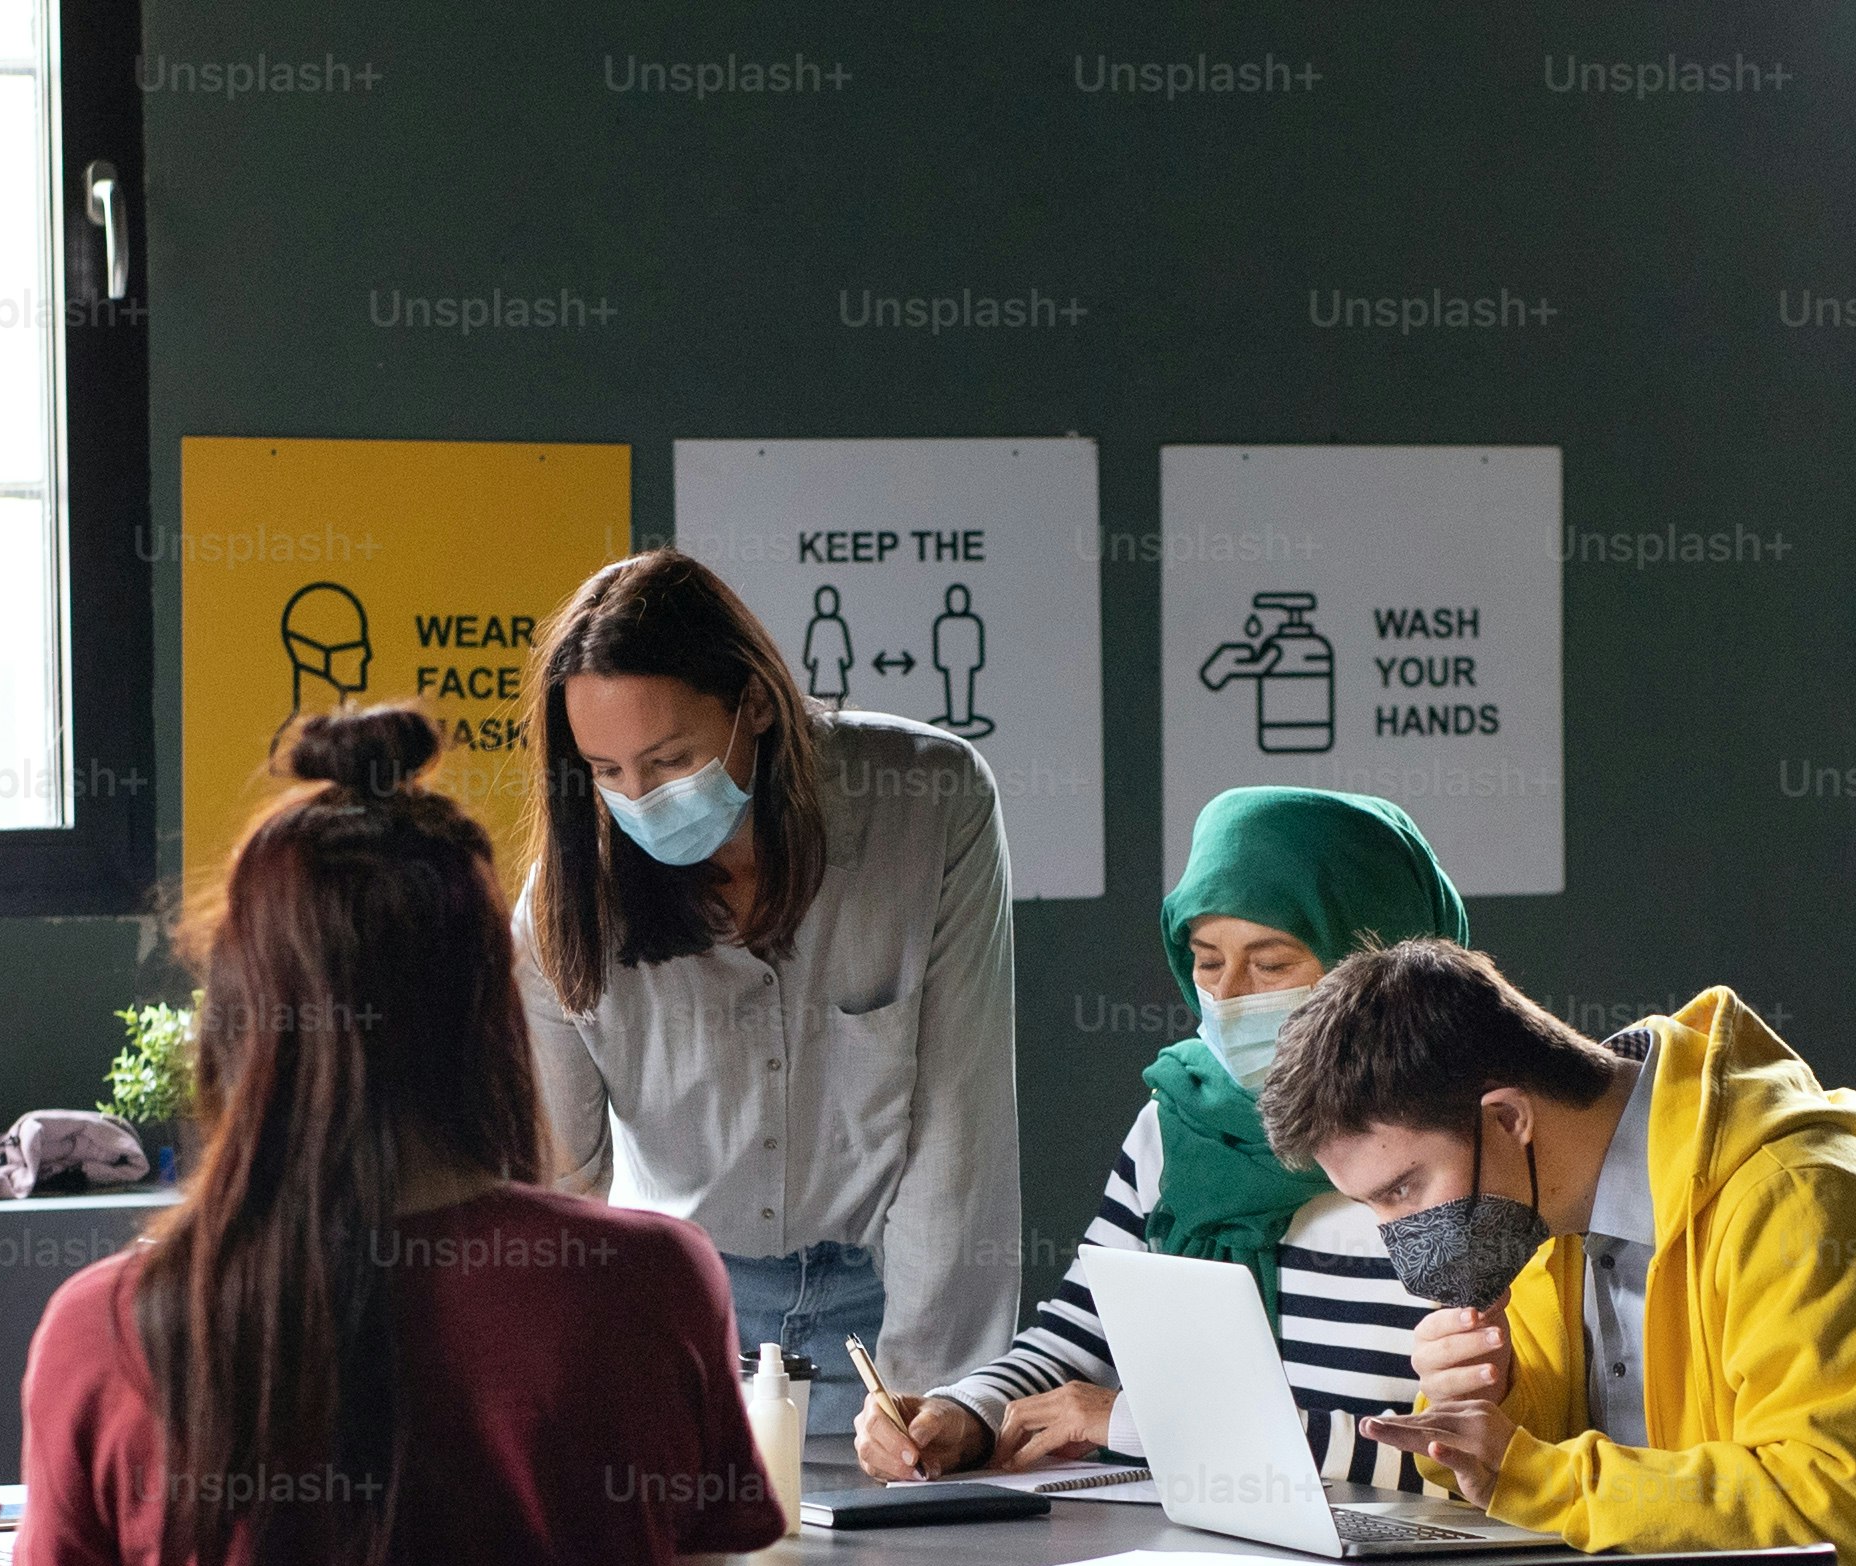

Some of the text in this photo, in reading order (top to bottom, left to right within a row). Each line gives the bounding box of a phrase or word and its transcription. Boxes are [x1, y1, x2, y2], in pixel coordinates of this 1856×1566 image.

[798, 530, 985, 563] KEEP THE
[415, 615, 535, 648] WEAR
[1374, 608, 1479, 640] WASH
[417, 666, 520, 700] FACE
[1375, 656, 1476, 688] YOUR
[438, 718, 530, 751] ASK
[1375, 703, 1500, 736] HANDS
